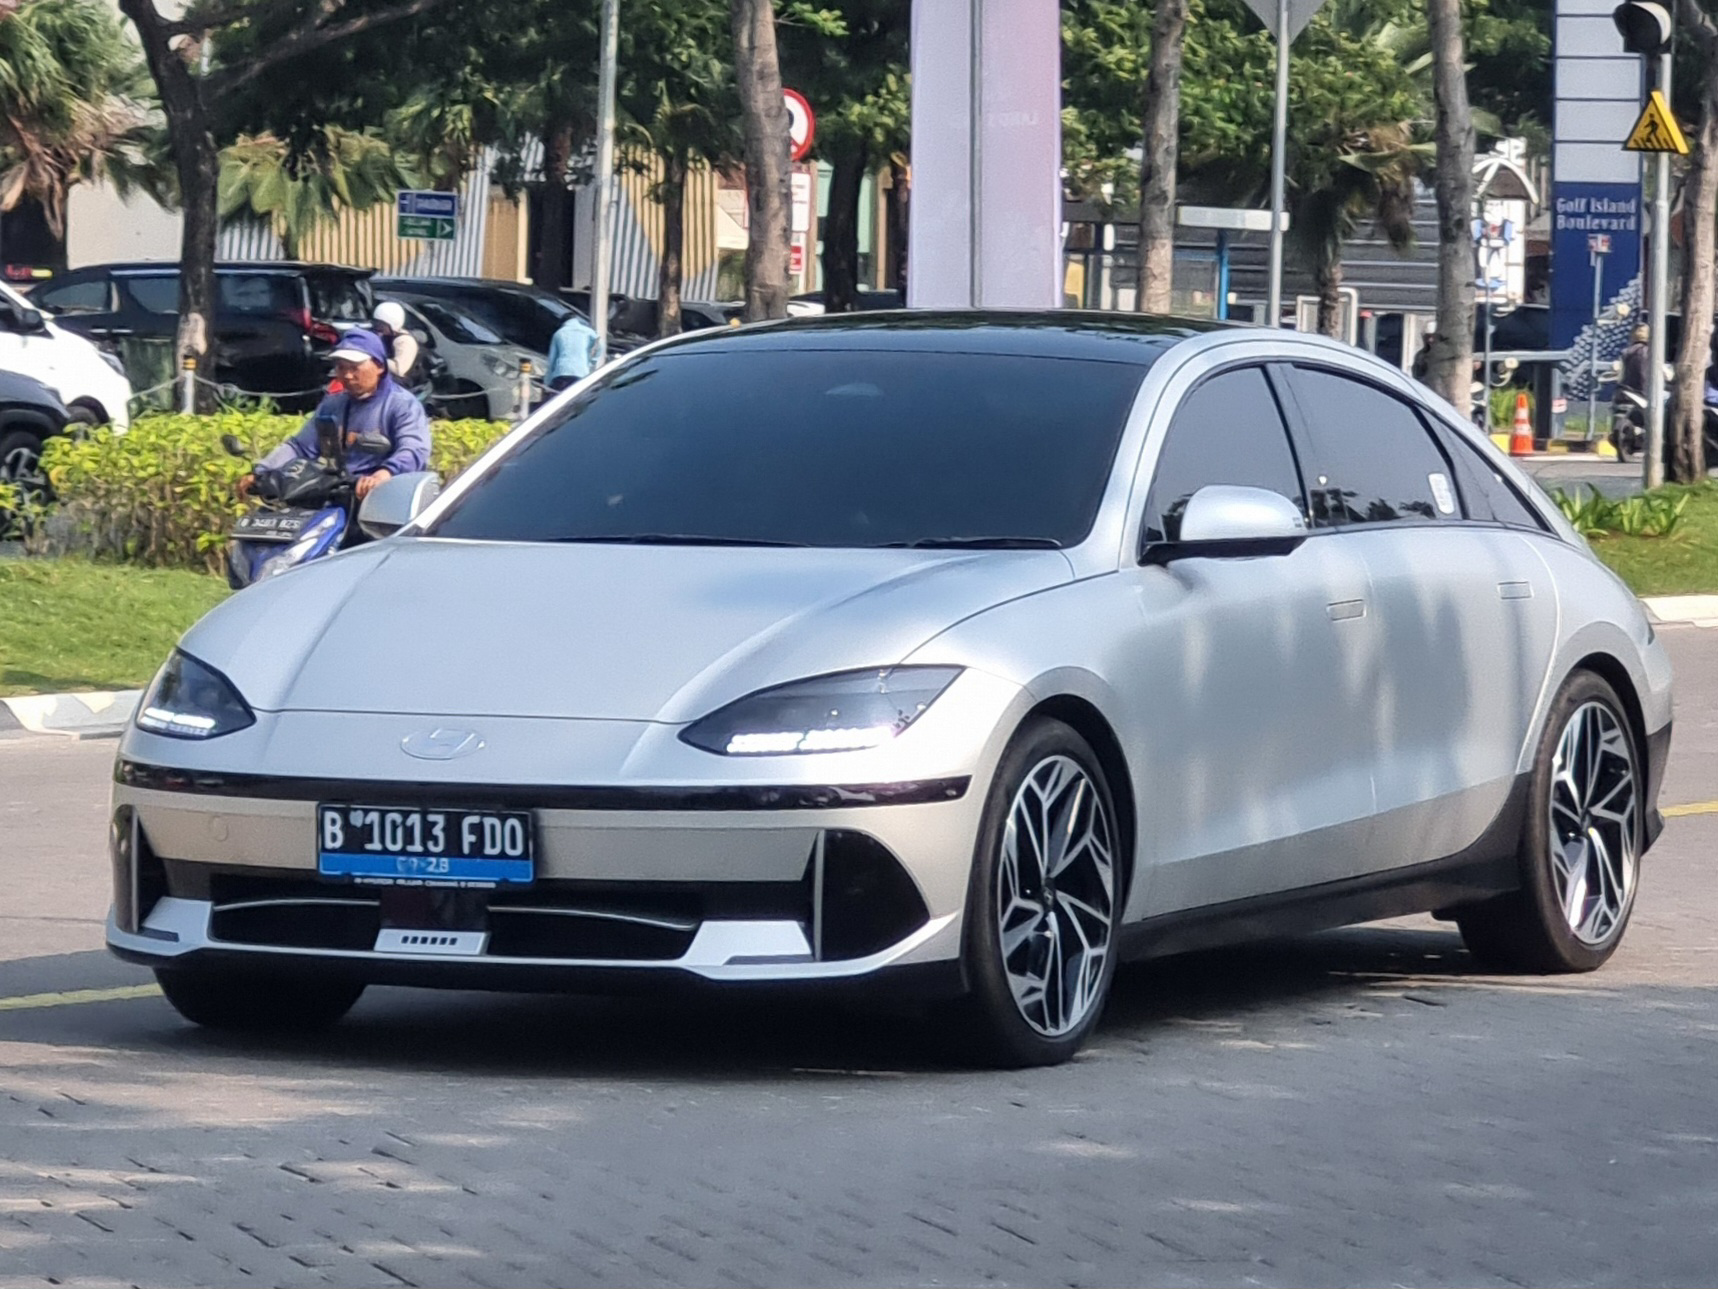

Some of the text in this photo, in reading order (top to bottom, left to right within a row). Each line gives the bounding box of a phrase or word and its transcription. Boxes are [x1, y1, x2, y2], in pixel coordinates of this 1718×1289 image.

[1556, 197, 1636, 213] Golf Island
[1556, 214, 1636, 230] Boulevard
[323, 810, 344, 850] B
[364, 811, 446, 853] 1013
